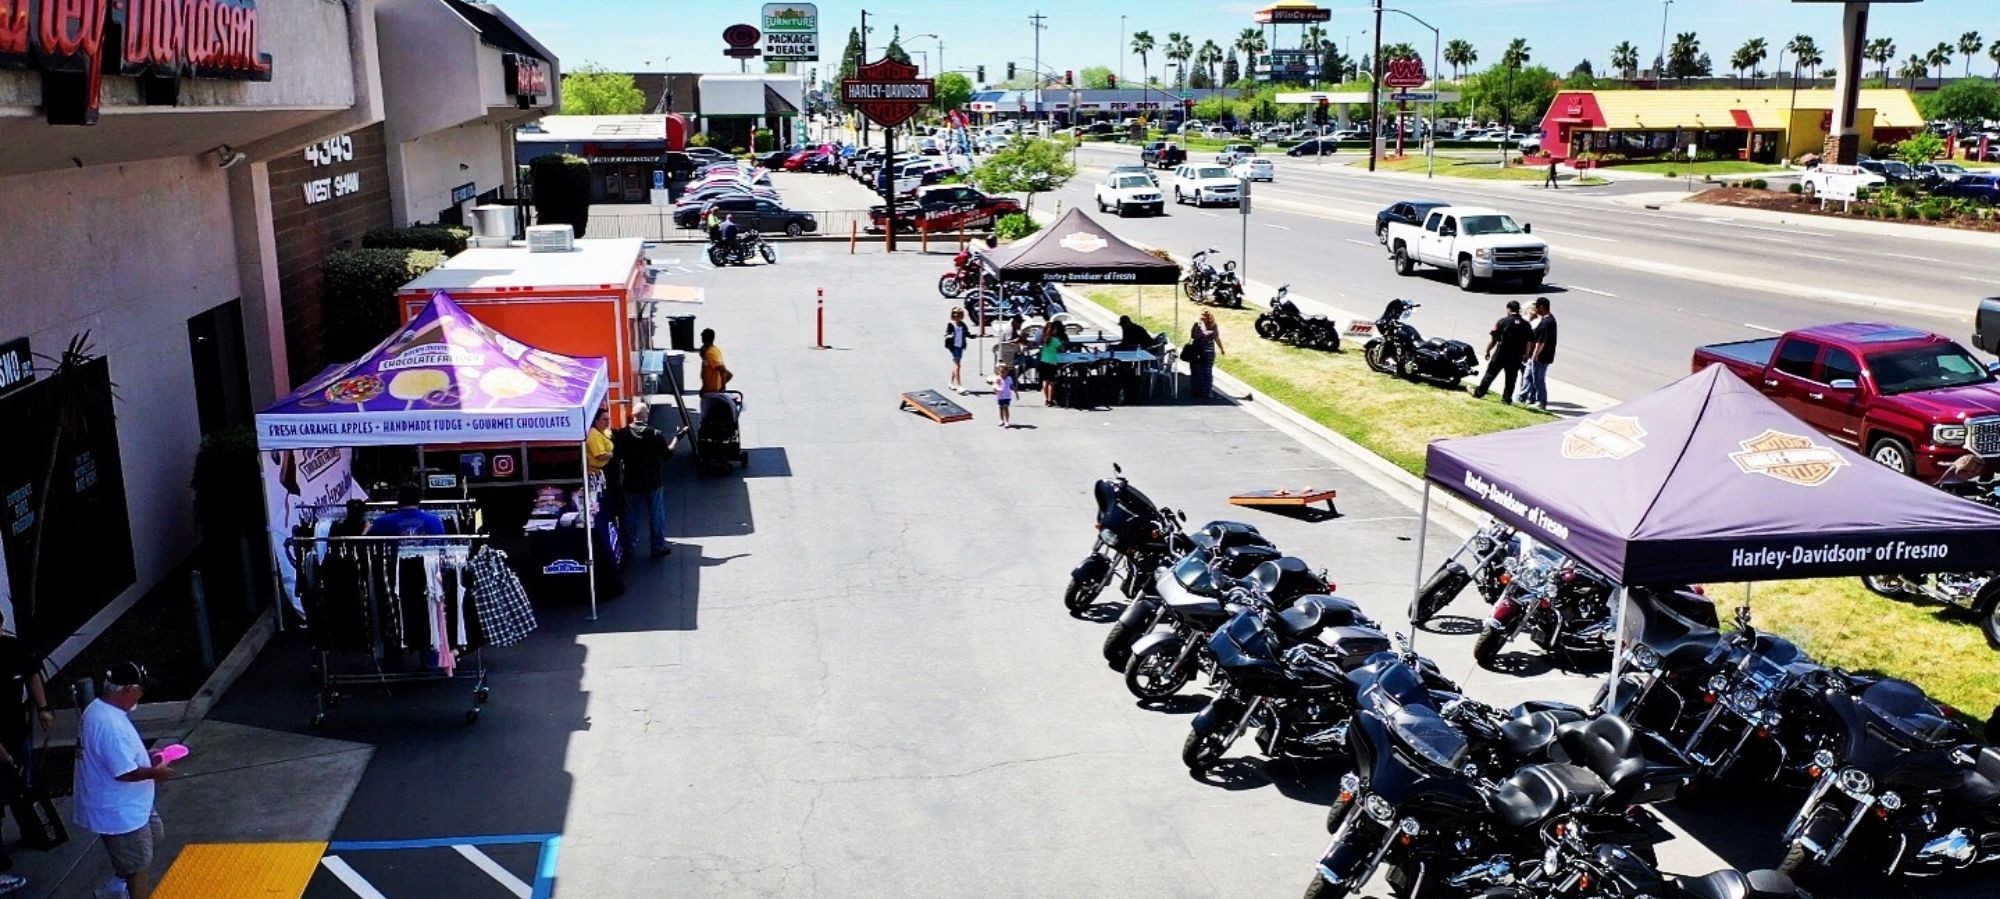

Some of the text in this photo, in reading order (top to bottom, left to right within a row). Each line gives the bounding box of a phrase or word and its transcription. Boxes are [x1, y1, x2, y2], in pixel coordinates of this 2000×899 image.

[765, 15, 815, 27] FURNITURE
[768, 34, 812, 43] PACKAGE
[775, 46, 806, 54] DEALS
[848, 84, 929, 98] HARLEY-DAVIDSON
[304, 134, 352, 167] 4345
[303, 172, 359, 204] WEST SHAW
[1112, 272, 1137, 280] Fresno
[383, 355, 436, 368] CHOCOLATE
[269, 416, 571, 436] FRESH CARAMEL APPLES HANDMADE FUDGE GOURMET CHOCOLATES
[1464, 470, 1569, 540] Harley-Davidson of Fresno
[1876, 541, 1895, 560] of
[1896, 541, 1948, 560] Fresno
